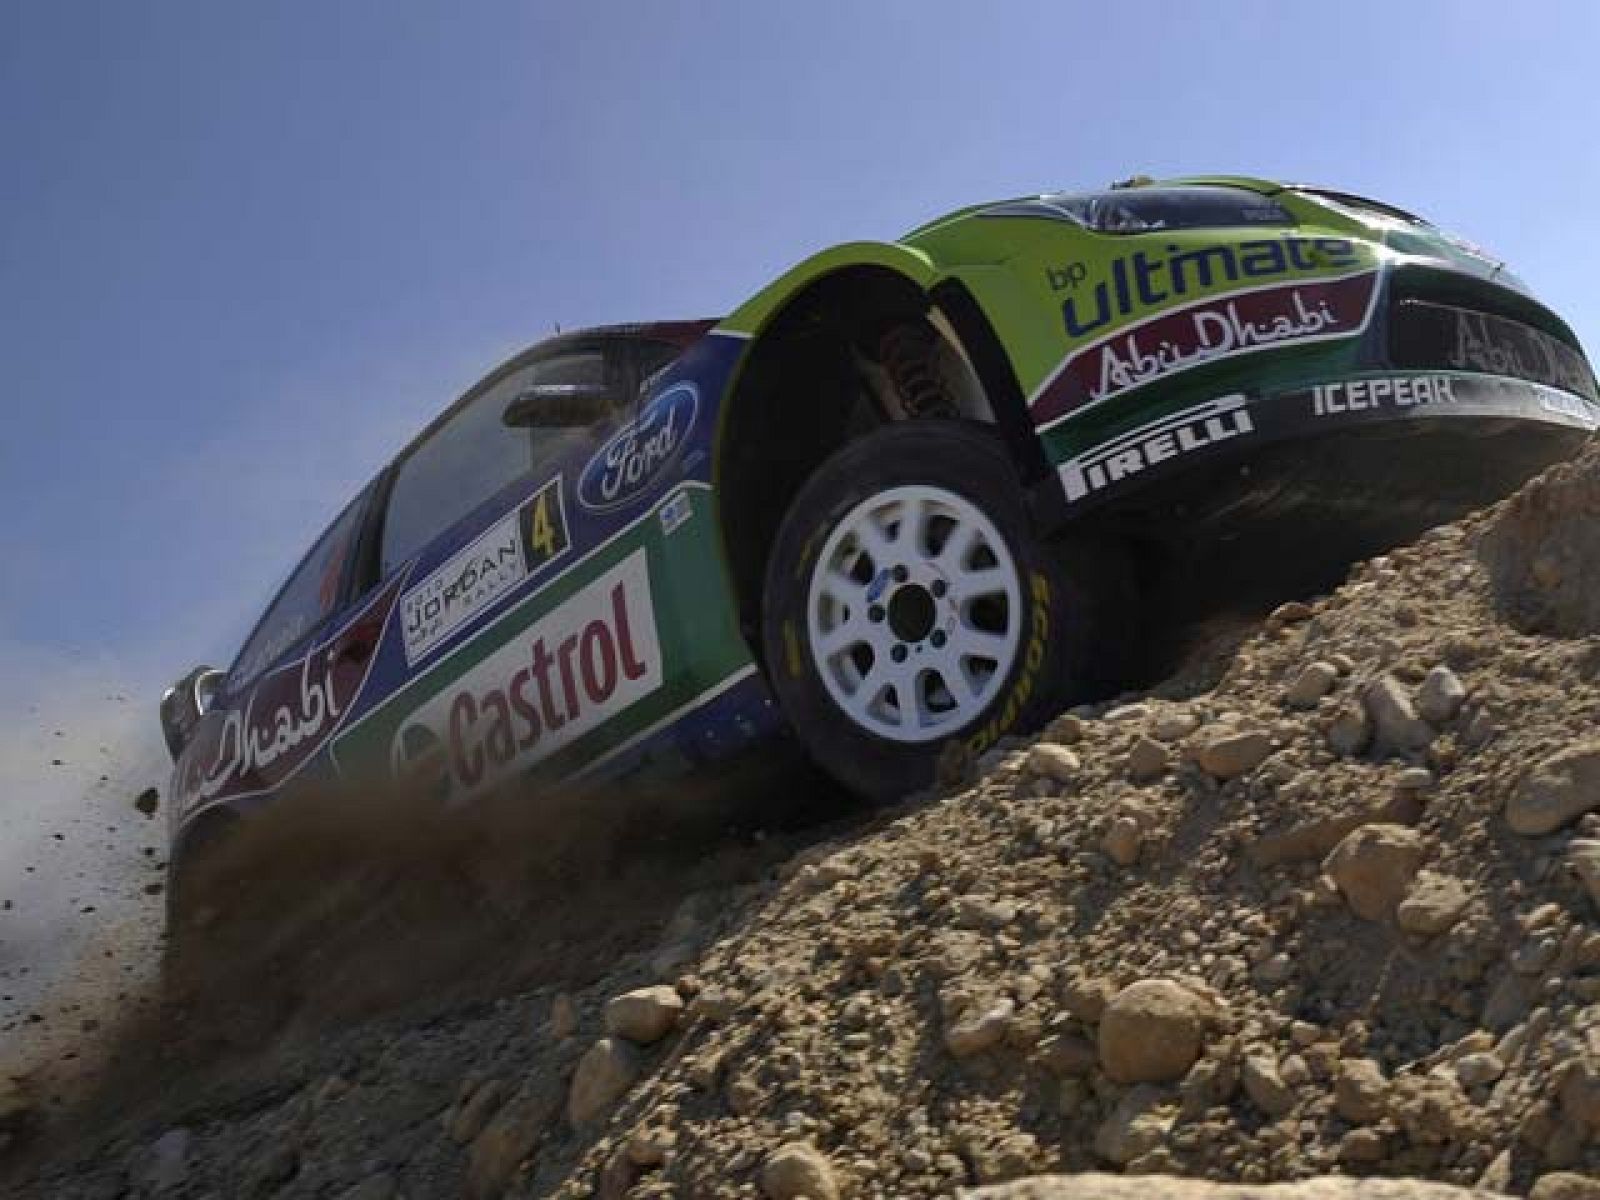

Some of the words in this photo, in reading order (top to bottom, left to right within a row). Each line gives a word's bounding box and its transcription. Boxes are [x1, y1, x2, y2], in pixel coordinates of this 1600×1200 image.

[1046, 261, 1087, 291] bp
[1062, 236, 1360, 337] ultimate
[1090, 334, 1180, 400] Abu
[1191, 288, 1338, 359] Dhabi
[1313, 375, 1457, 416] ICEPEAK
[602, 403, 679, 500] Ford
[1056, 393, 1254, 502] PIRELLI
[531, 494, 555, 555] 4
[408, 539, 516, 633] JORDAN
[450, 579, 647, 787] Castrol
